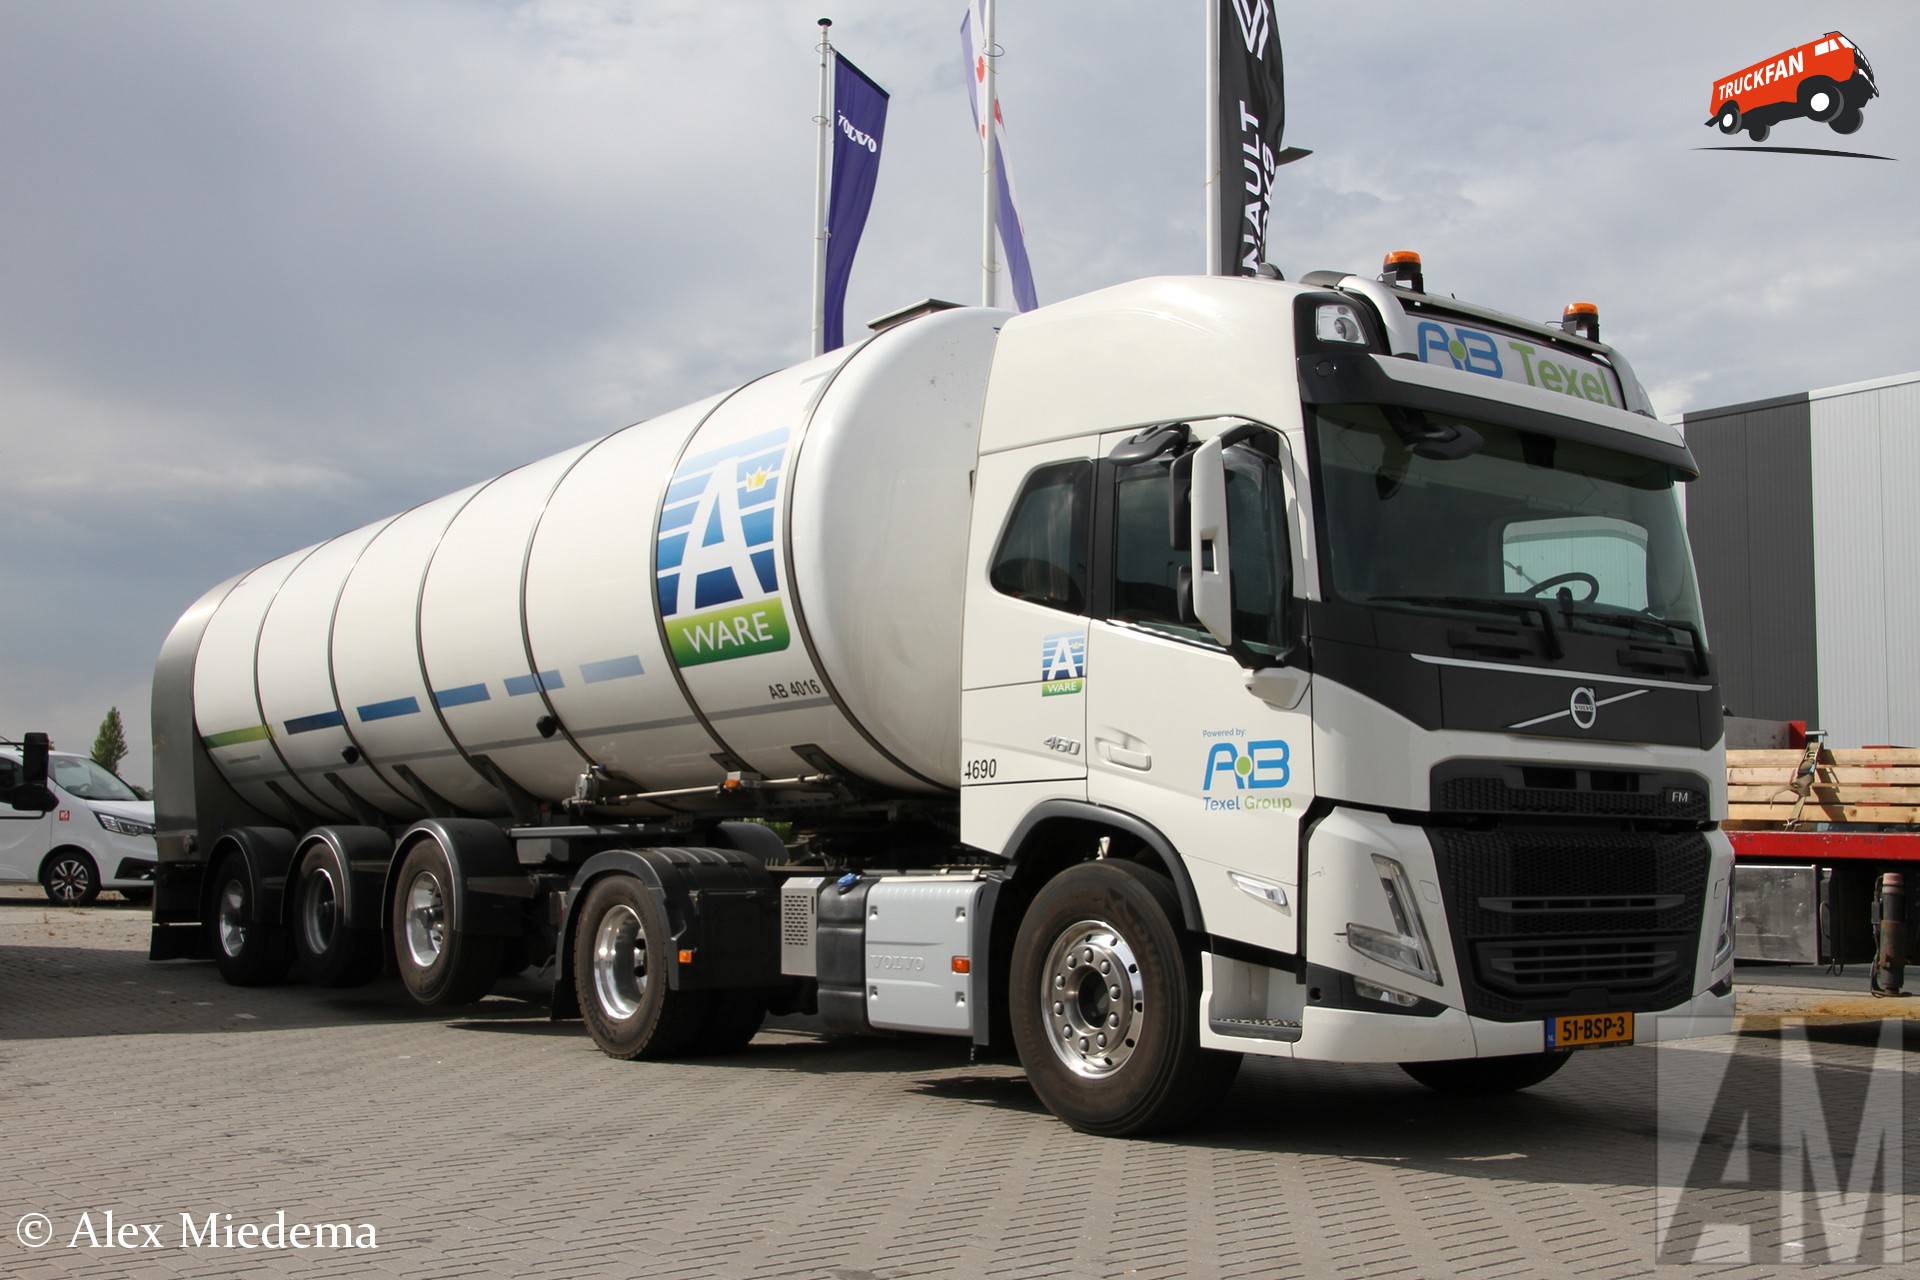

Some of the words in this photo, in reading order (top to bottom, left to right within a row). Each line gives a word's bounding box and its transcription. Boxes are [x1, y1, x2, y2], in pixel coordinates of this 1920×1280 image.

[1239, 99, 1262, 277] NAULT
[1417, 321, 1504, 379] AB
[1508, 341, 1617, 407] Texel
[683, 611, 774, 654] WARE
[769, 683, 789, 700] AB
[790, 678, 821, 697] 4016
[1047, 682, 1078, 694] WARE
[1202, 728, 1234, 738] Powered
[1043, 736, 1081, 756] 460
[964, 758, 997, 780] 4690
[1203, 739, 1290, 791] AB
[1202, 795, 1241, 812] Texel
[1243, 794, 1292, 812] Group
[1671, 791, 1689, 803] FM
[869, 954, 925, 971] VOLVO
[1562, 1015, 1625, 1042] 51-BSP-3
